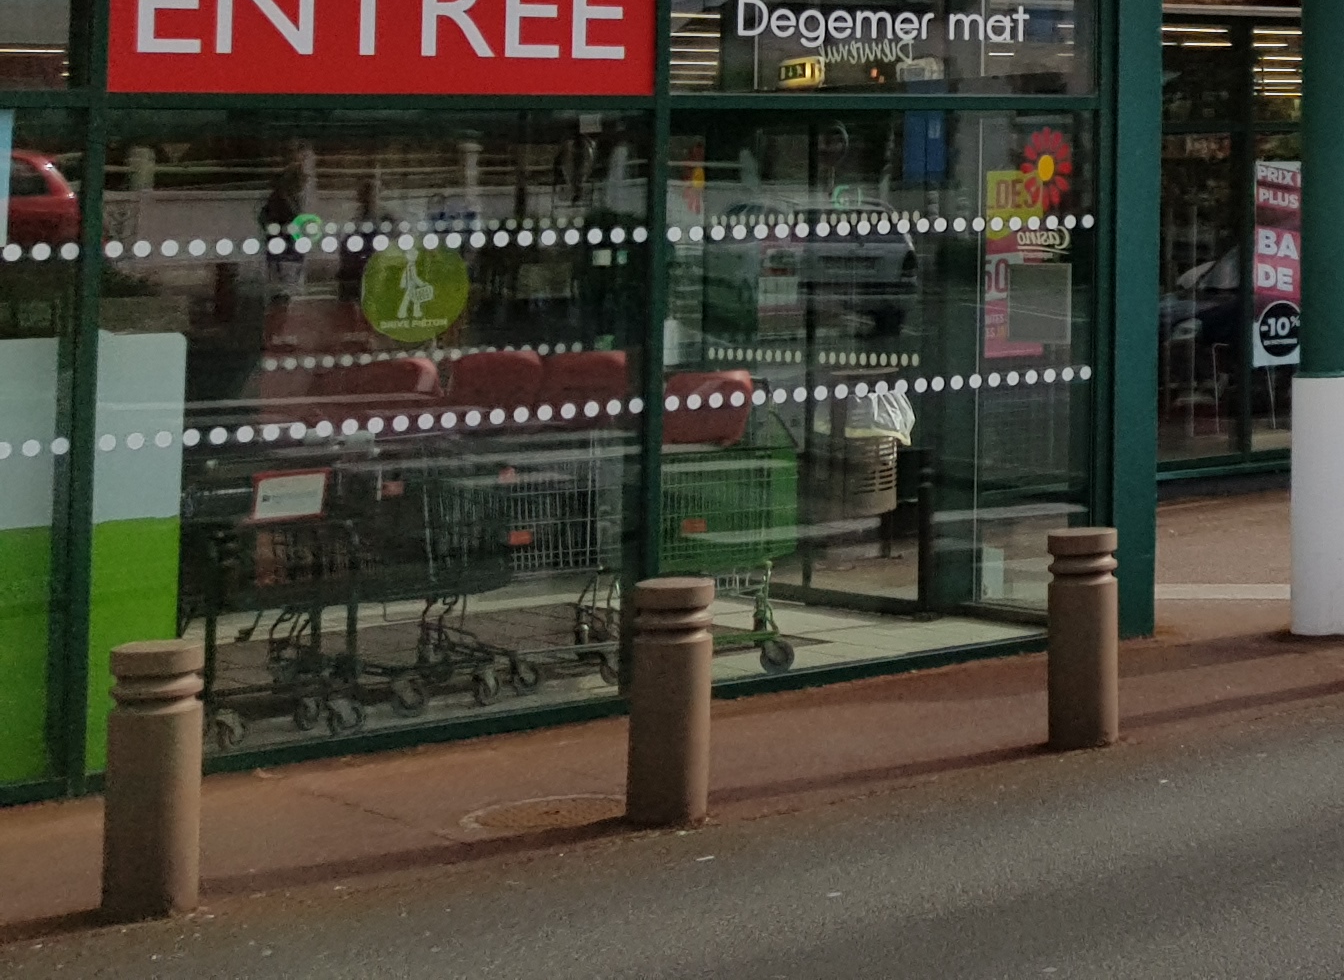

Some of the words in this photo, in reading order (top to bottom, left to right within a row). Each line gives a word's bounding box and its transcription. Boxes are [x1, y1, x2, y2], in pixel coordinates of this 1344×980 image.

[948, 5, 1030, 42] mat
[1257, 165, 1293, 184] PRIX
[1258, 188, 1299, 209] PLUS
[1257, 263, 1294, 292] DE
